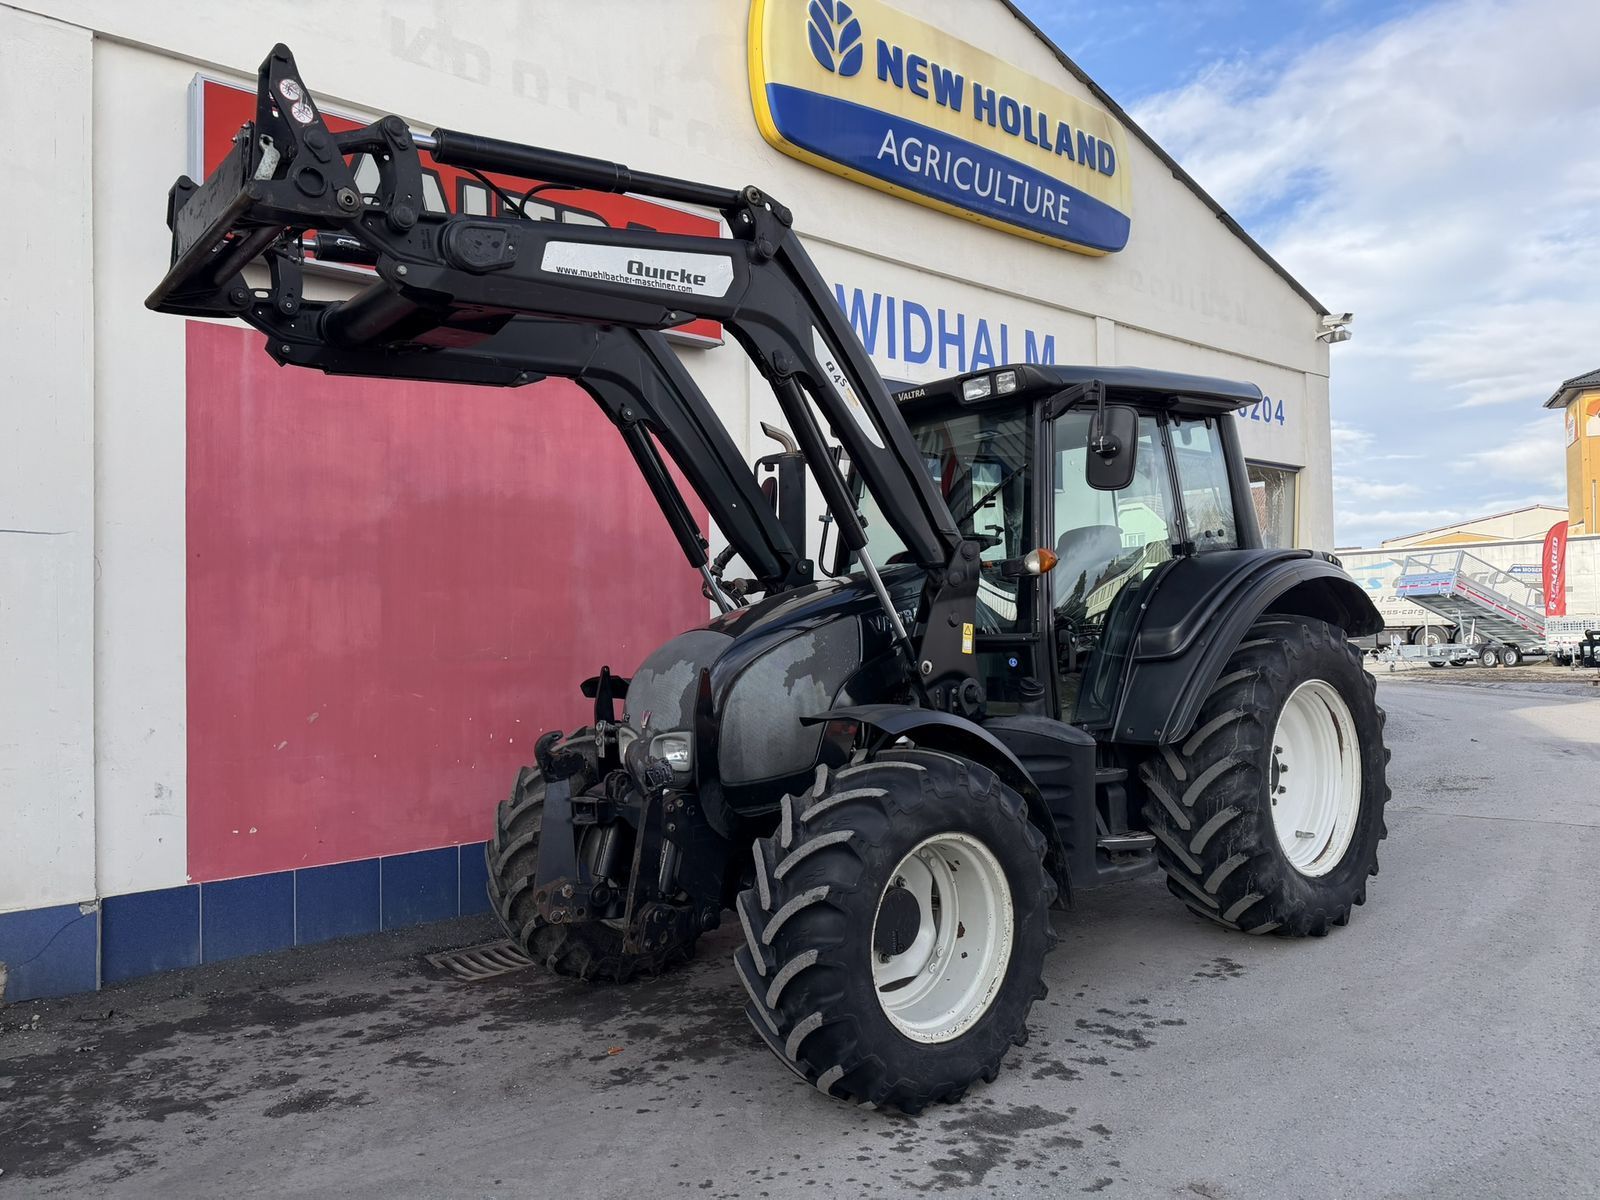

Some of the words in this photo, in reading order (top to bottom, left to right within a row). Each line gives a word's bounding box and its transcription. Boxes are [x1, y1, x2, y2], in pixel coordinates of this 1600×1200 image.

[876, 38, 964, 113] NEW
[972, 81, 1117, 178] HOLLAND
[877, 129, 1071, 226] AGRICULTURE
[555, 265, 694, 294] www.muehlbacher-maschinen.com
[627, 260, 706, 287] Quicke
[834, 283, 1056, 373] WIDHALM
[898, 388, 926, 402] VALTRA
